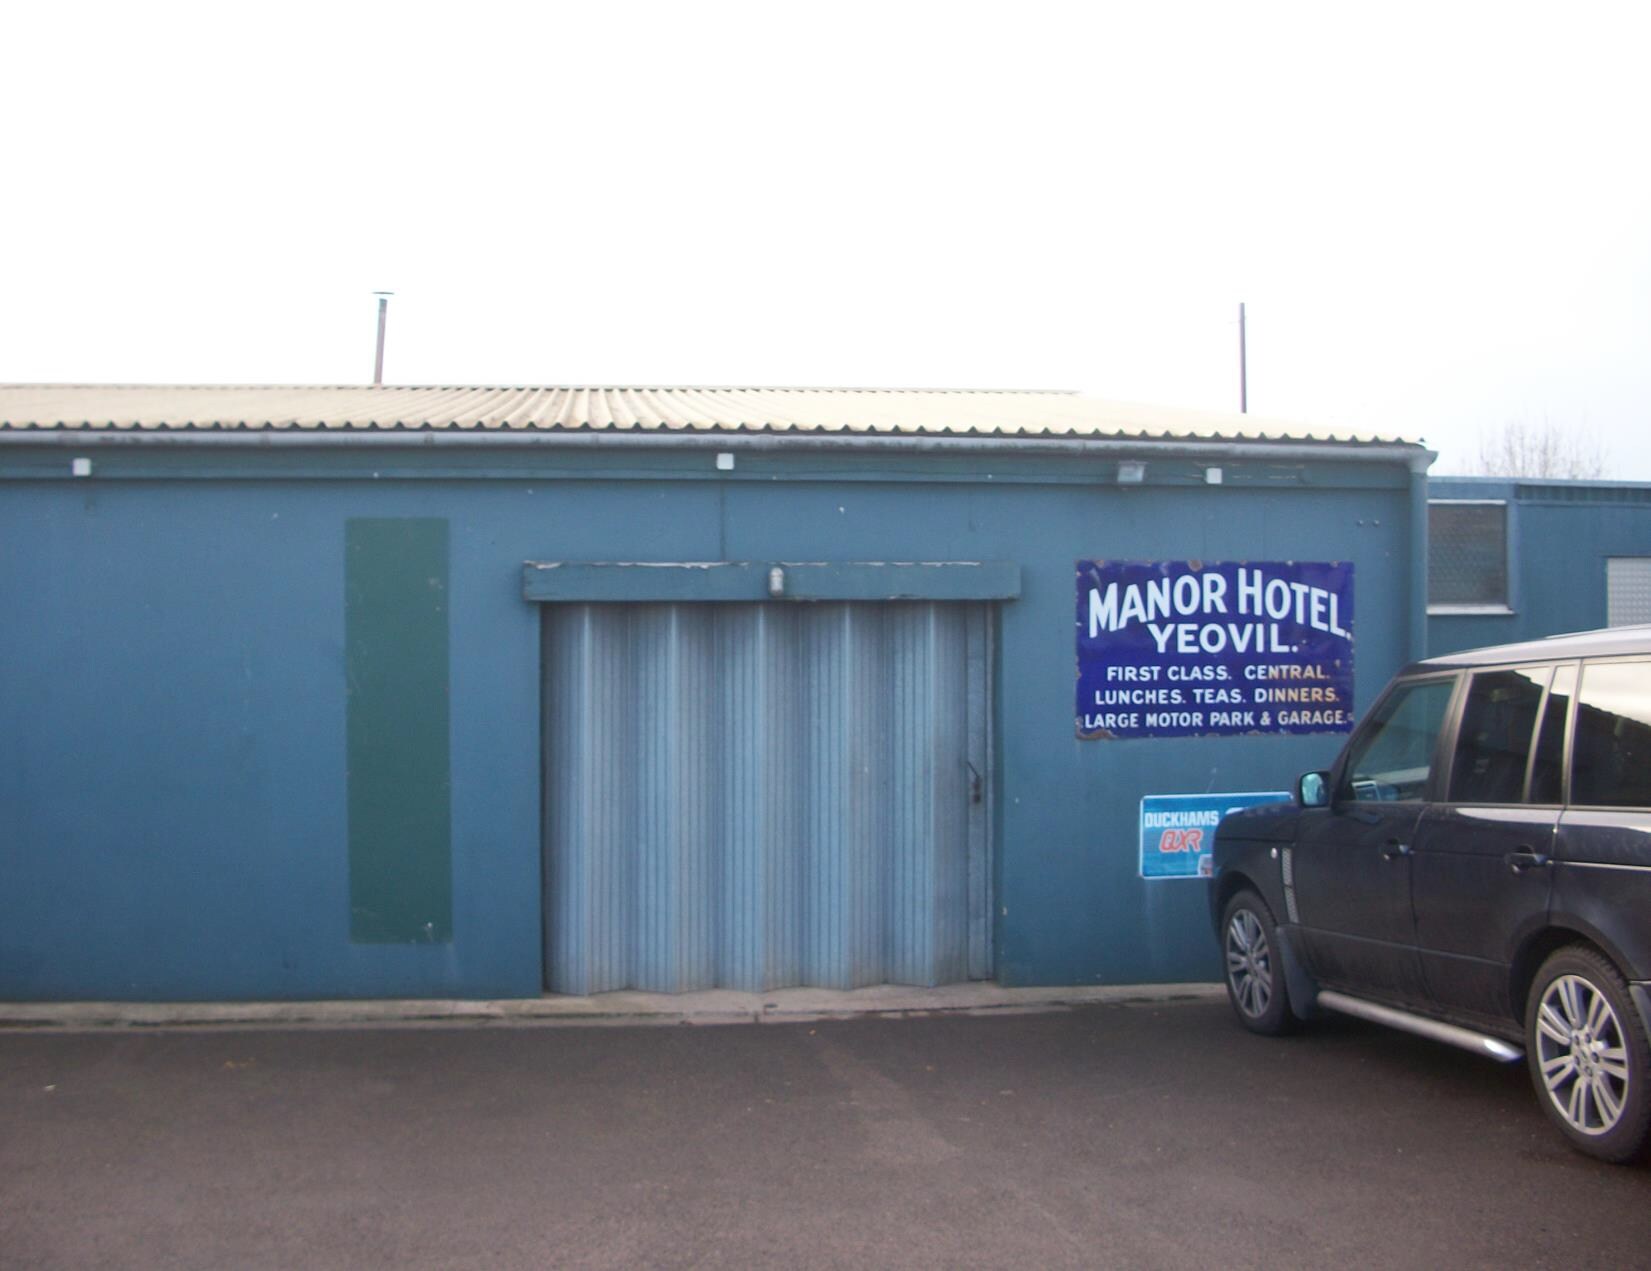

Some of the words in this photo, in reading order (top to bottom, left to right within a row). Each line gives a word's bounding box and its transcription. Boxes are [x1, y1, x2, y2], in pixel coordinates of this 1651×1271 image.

[1089, 573, 1228, 638] MANOR
[1238, 568, 1352, 640] HOTEL.
[1147, 623, 1299, 653] YEOVIL.
[1107, 666, 1161, 681] FIRST
[1167, 665, 1232, 680] CLASS.
[1244, 665, 1330, 680] CENTRAL.
[1095, 689, 1186, 704] LUNCHES.
[1193, 688, 1246, 703] TEAS.
[1255, 687, 1340, 702] DINNERS.
[1085, 713, 1138, 728] LARGE
[1146, 712, 1203, 727] MOTOR
[1210, 711, 1255, 727] PARK
[1260, 711, 1271, 726] &
[1278, 710, 1347, 725] GARAGE.
[1144, 810, 1219, 828] DUCKHAMS
[1159, 829, 1203, 853] QXR
